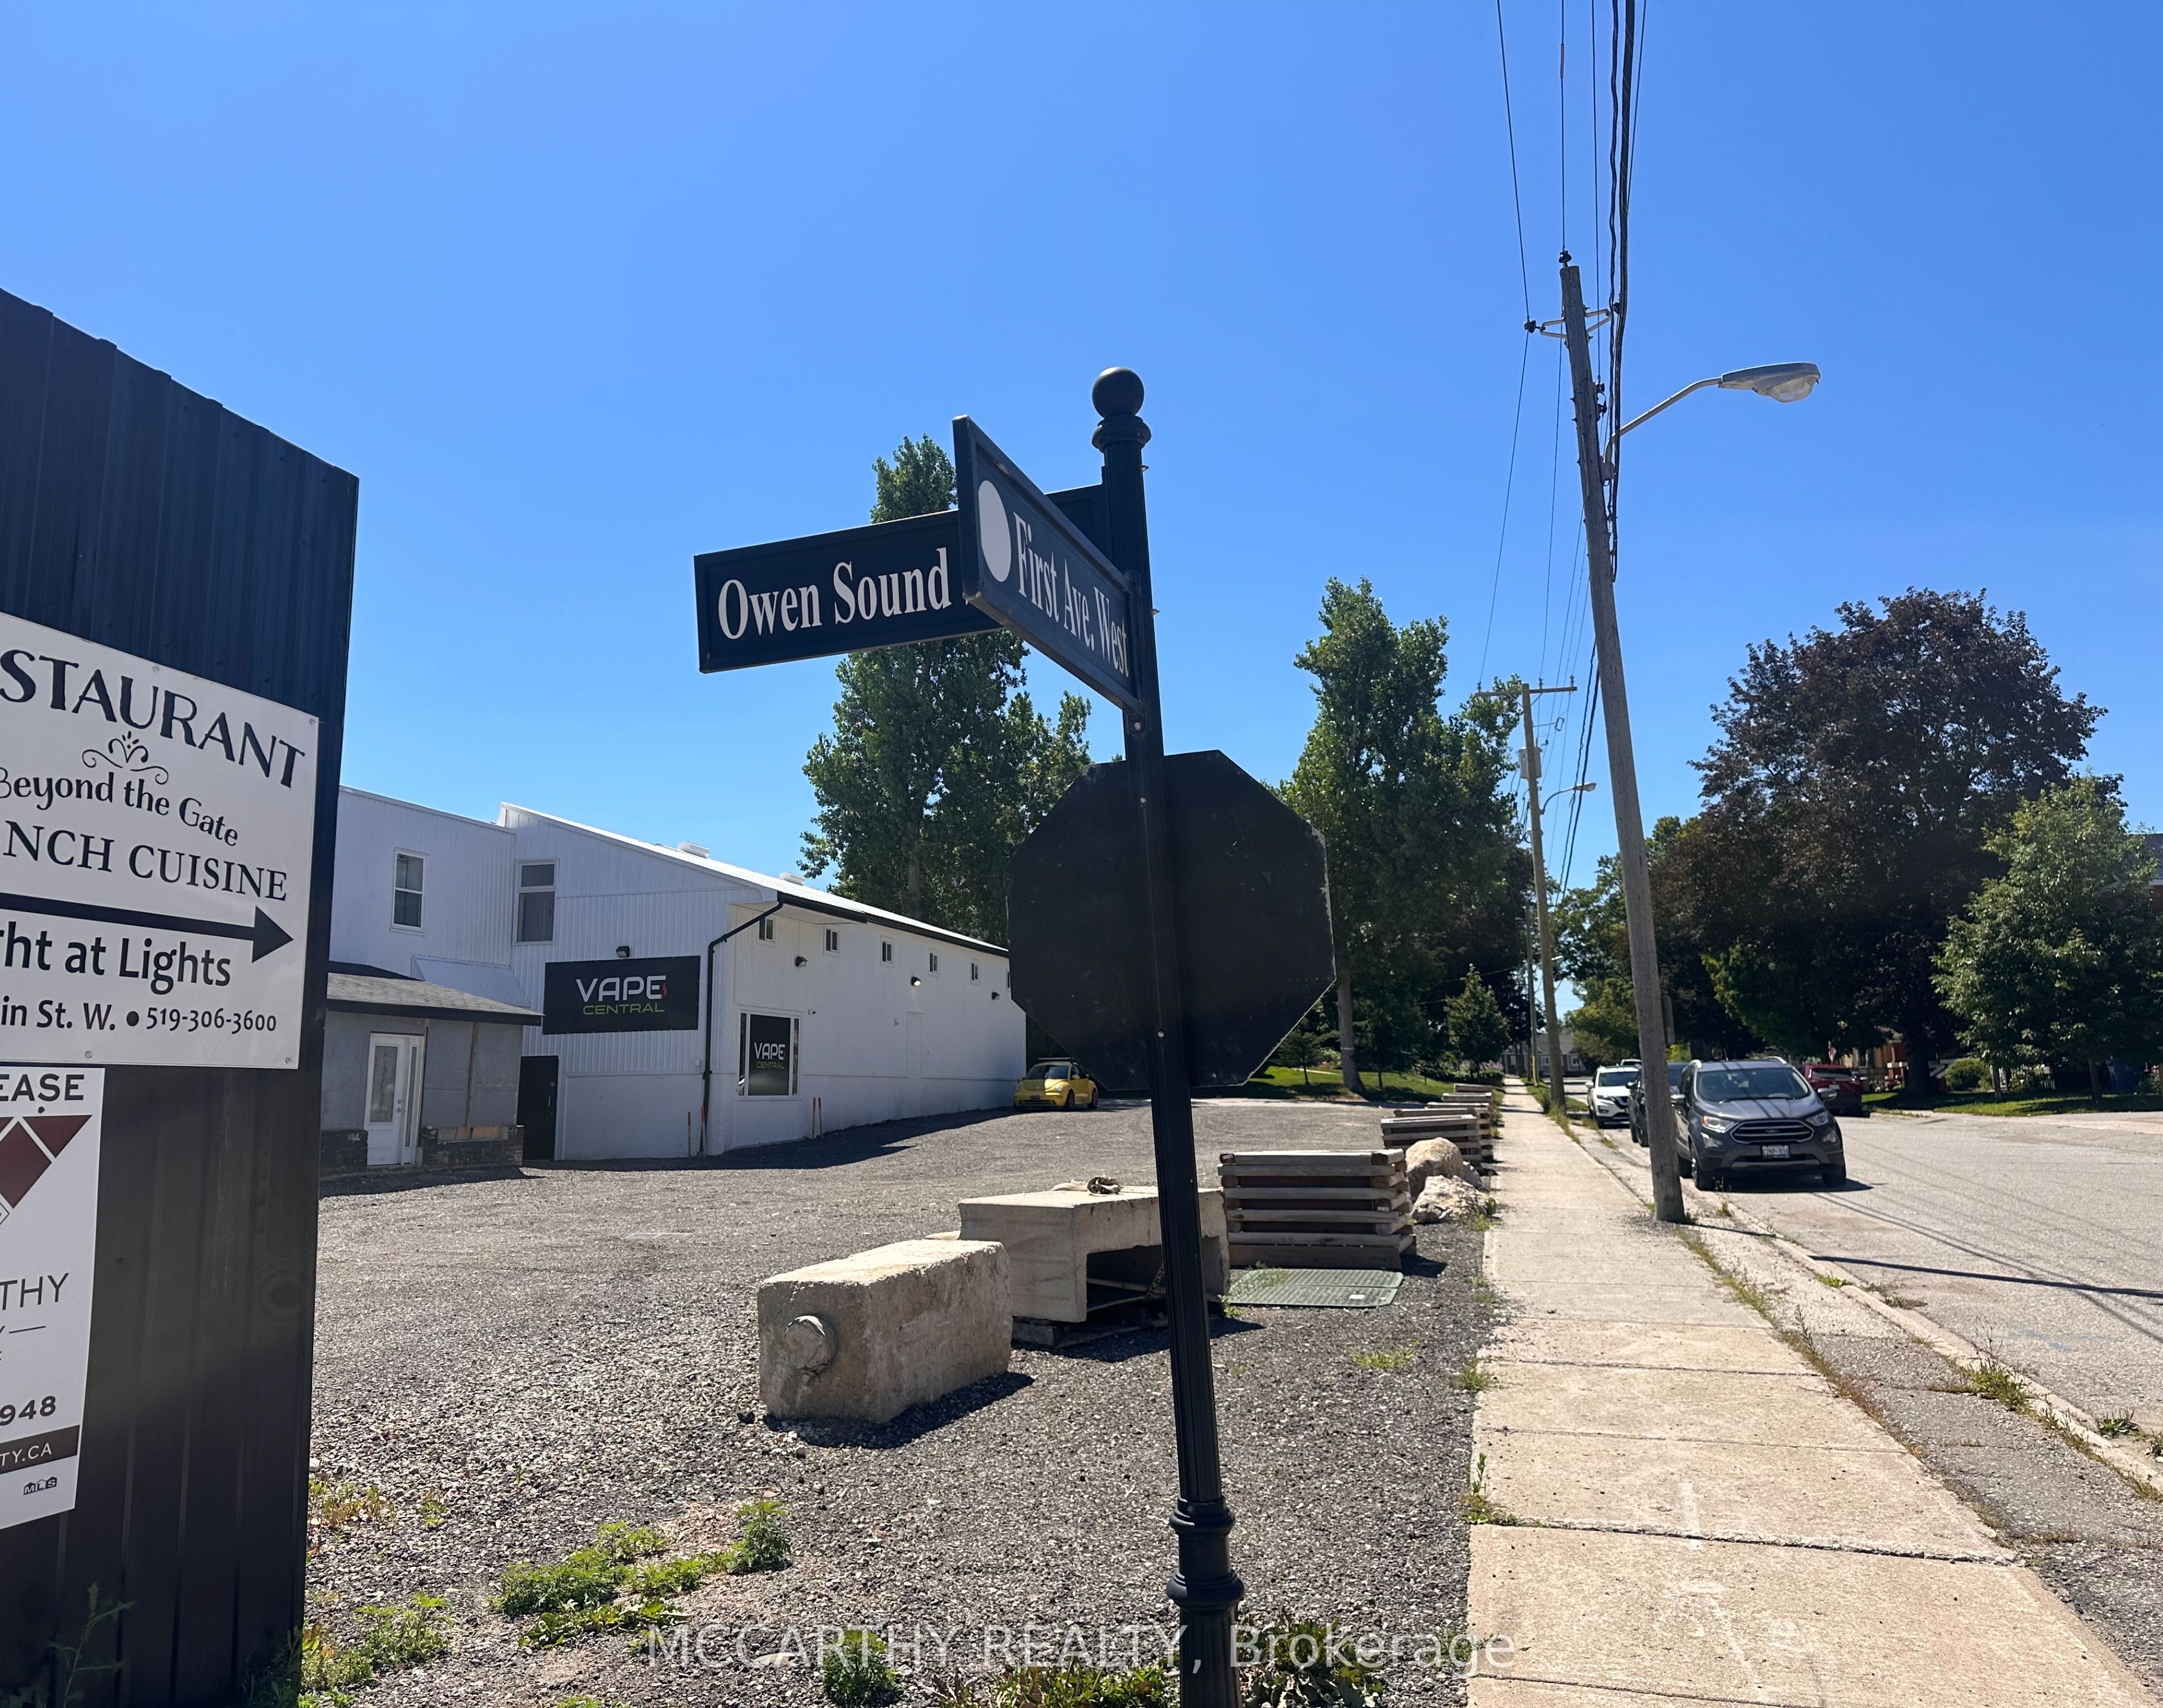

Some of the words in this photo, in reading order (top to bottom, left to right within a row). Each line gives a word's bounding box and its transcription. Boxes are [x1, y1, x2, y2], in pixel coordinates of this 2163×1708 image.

[718, 579, 823, 639] Owen
[833, 547, 952, 624] Sound
[1013, 512, 1059, 623] First
[1063, 559, 1095, 651] Ave.
[1093, 586, 1129, 678] West
[0, 650, 305, 789] STAURANT
[123, 779, 170, 816] the
[179, 798, 238, 847] Gate
[3, 821, 114, 873] NCH
[129, 845, 287, 901] CUISINE
[0, 921, 52, 971] ht
[65, 936, 106, 976] at
[119, 938, 231, 995] Lights
[575, 976, 666, 1002] VAPE
[583, 1003, 665, 1015] CENTRAL
[1, 995, 27, 1027] in
[36, 999, 73, 1029] St.
[83, 1002, 116, 1031] W.
[146, 1008, 276, 1035] 519-306-3600
[754, 1042, 785, 1060] VAPE
[0, 1273, 69, 1311] THY
[0, 1395, 56, 1426] 948
[24, 1477, 57, 1495] MLS
